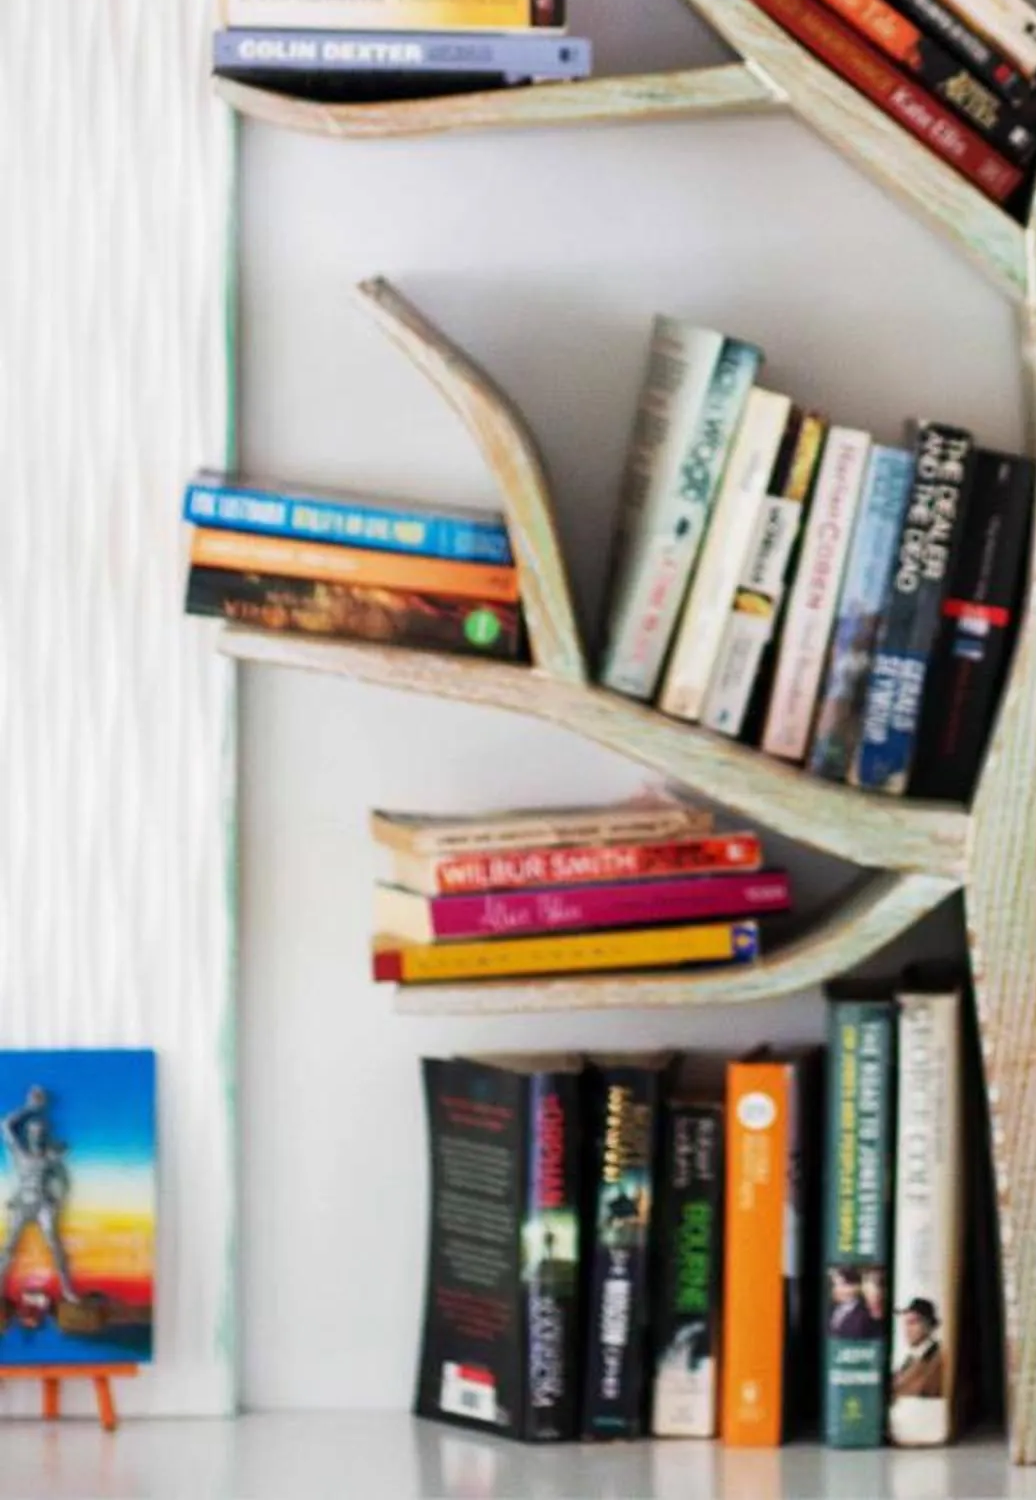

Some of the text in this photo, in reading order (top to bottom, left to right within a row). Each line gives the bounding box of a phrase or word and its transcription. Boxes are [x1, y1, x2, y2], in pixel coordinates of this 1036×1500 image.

[238, 39, 317, 62] COLIN
[322, 41, 423, 64] DEXTER
[892, 428, 946, 596] AND THE DEAD
[919, 434, 968, 582] THE DEALER
[440, 848, 638, 889] WILBUR SMITH
